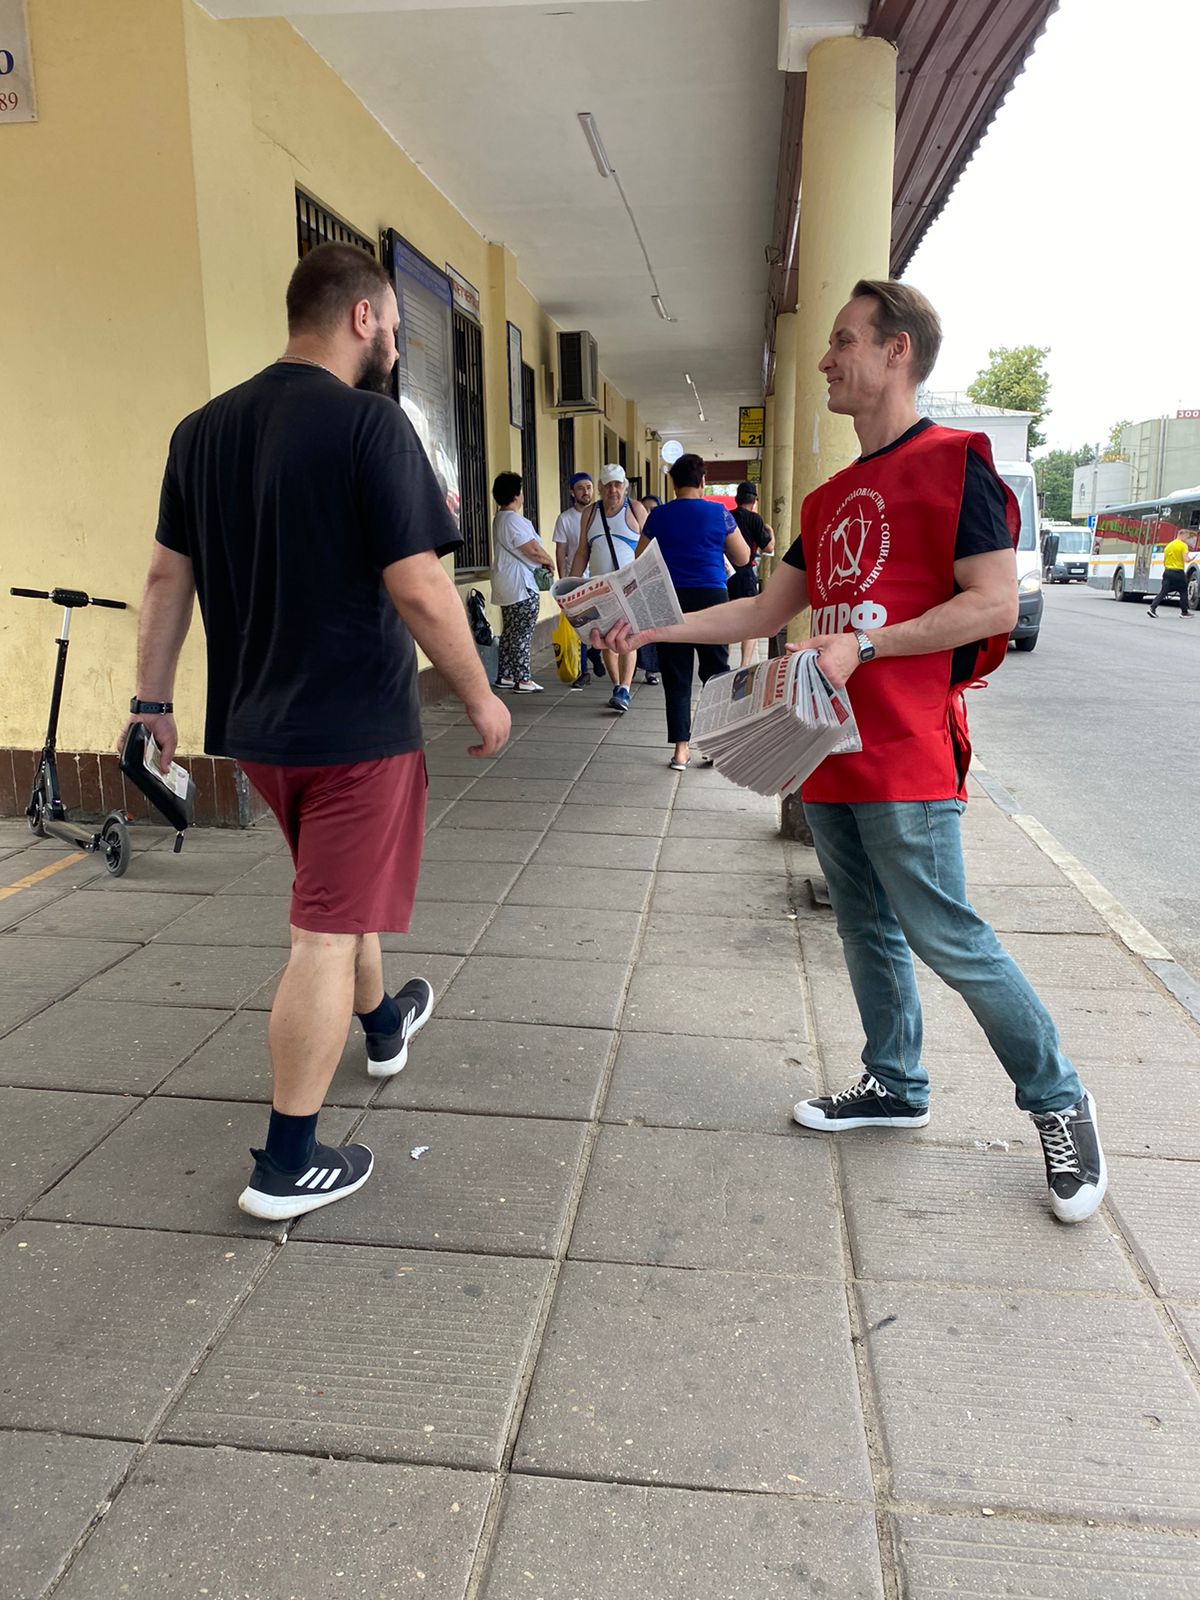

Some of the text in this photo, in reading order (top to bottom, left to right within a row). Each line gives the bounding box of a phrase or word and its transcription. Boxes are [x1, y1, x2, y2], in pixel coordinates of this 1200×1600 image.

[748, 434, 762, 445] 21
[859, 522, 890, 593] СОЦИАЛИЗМ
[812, 600, 887, 638] КПРФ
